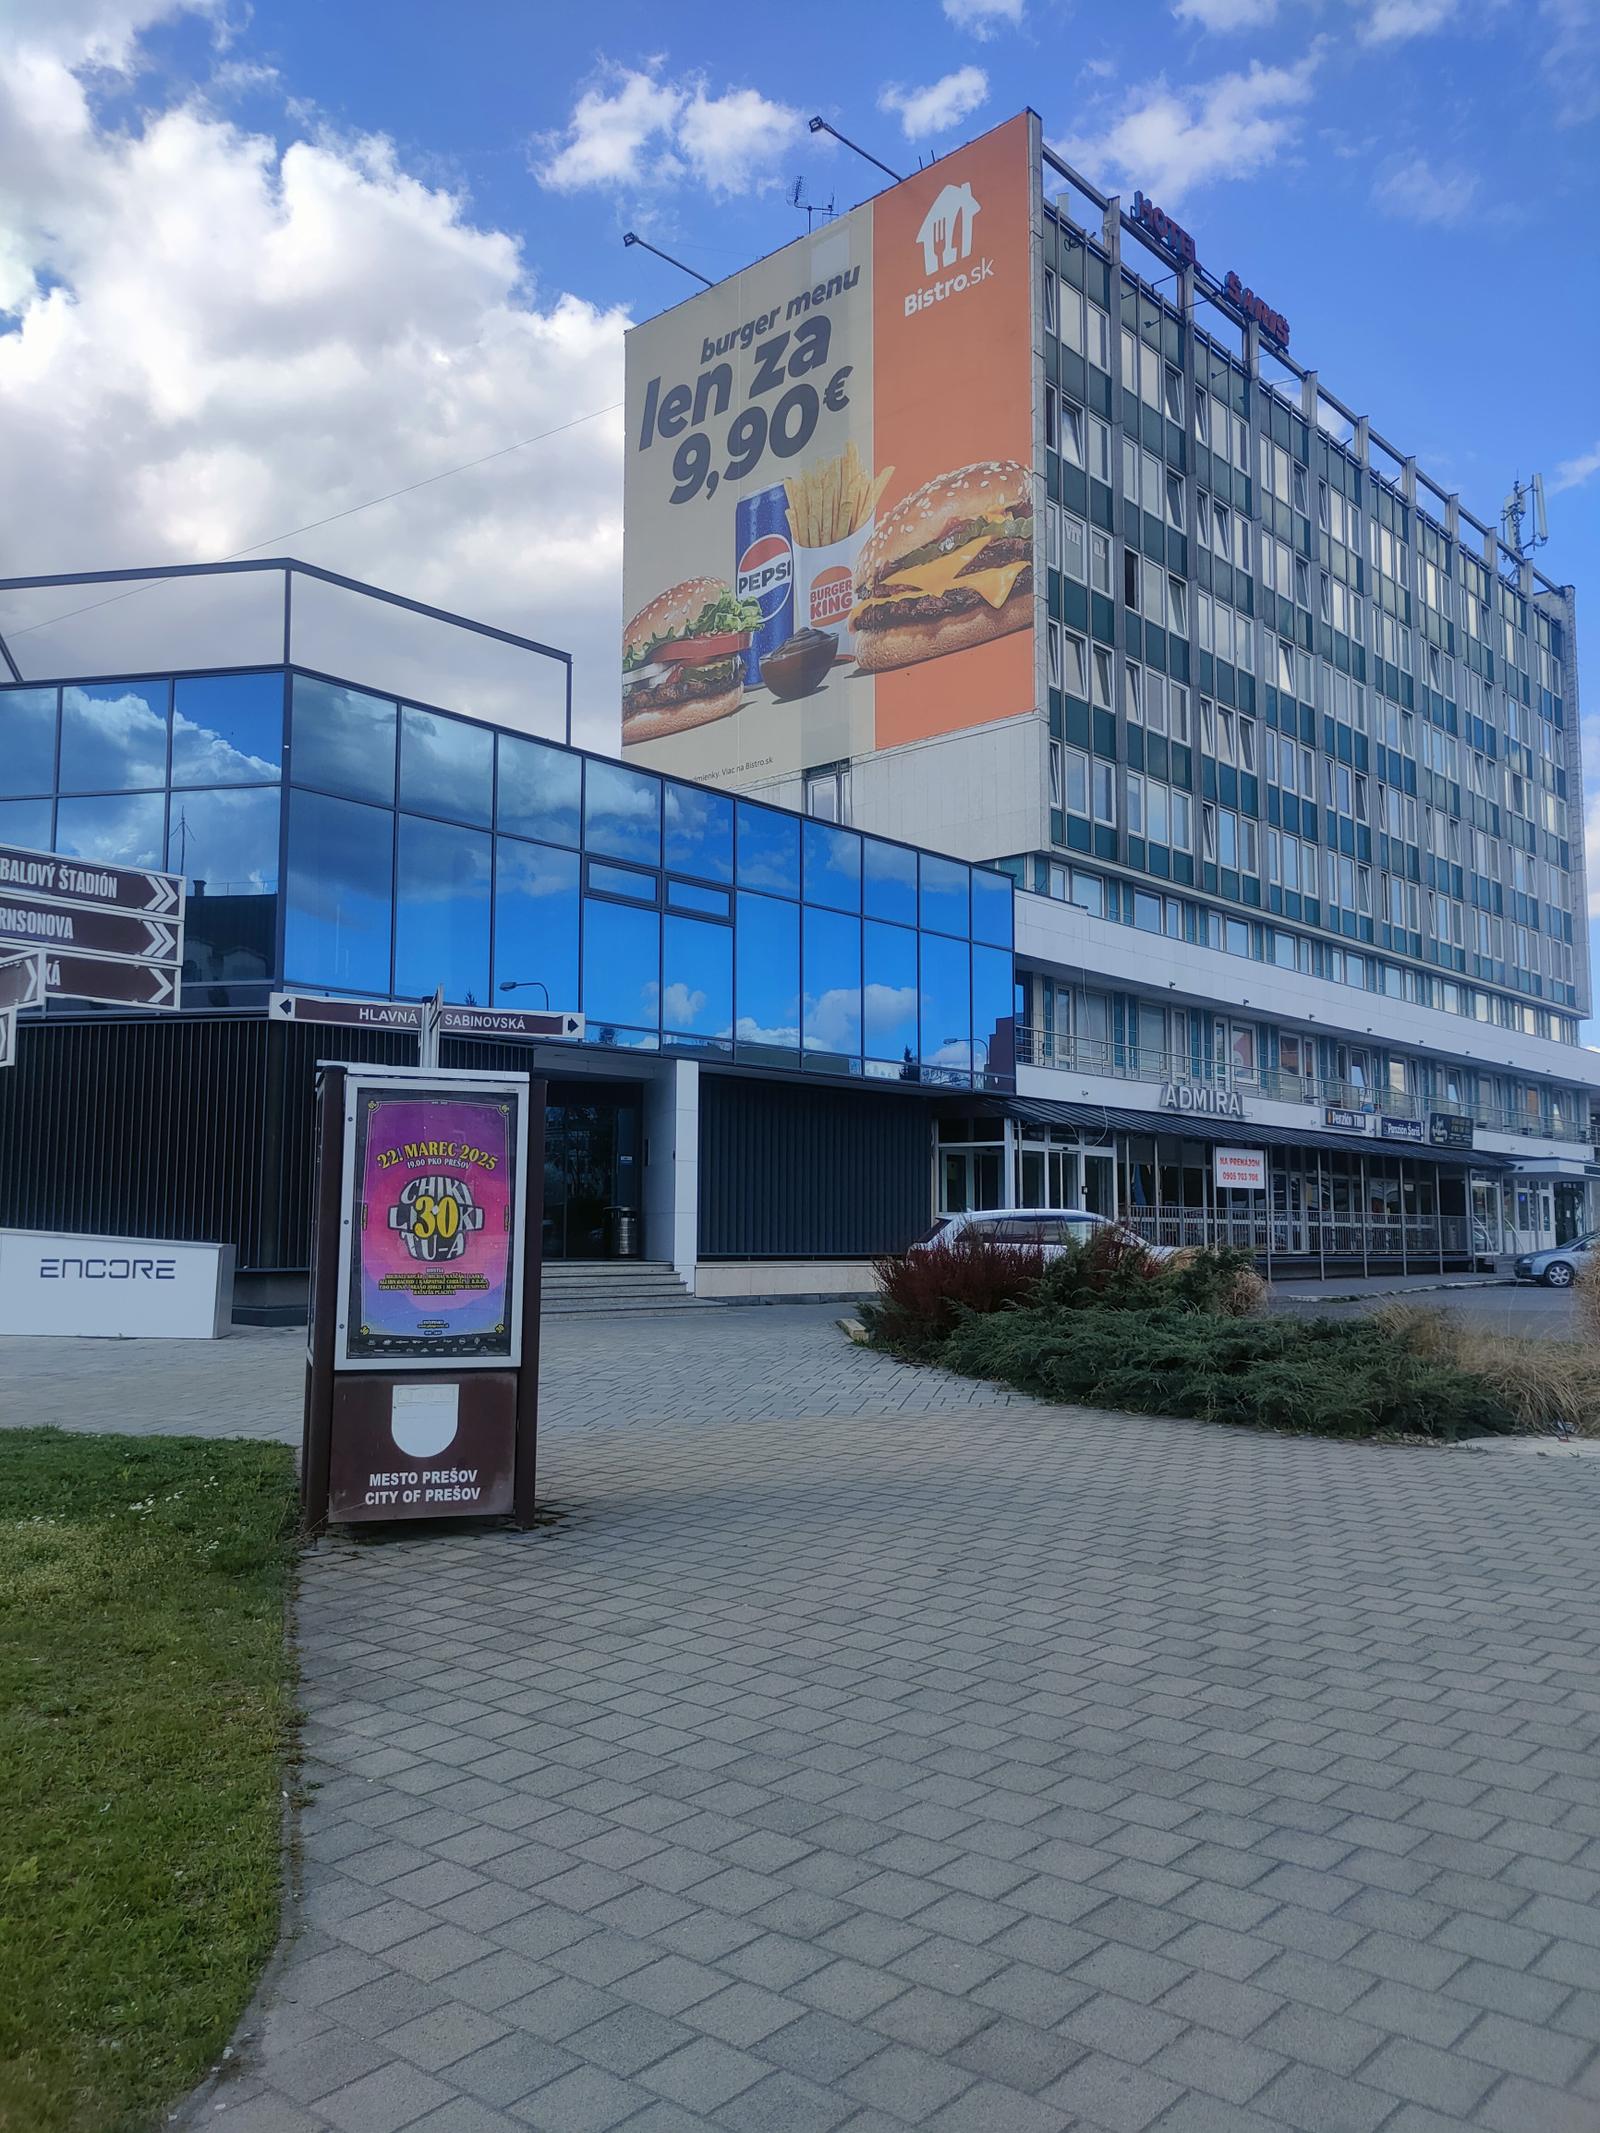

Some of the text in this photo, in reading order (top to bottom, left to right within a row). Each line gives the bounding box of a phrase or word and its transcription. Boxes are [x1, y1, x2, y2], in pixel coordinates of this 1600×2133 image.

[904, 256, 995, 317] Bistro.sk
[700, 265, 861, 365] burger menu
[639, 315, 832, 452] len za
[738, 559, 791, 594] PEPSI
[810, 579, 853, 604] BURGER
[810, 592, 853, 620] KING
[0, 857, 118, 899] BALOVÝ ŠTADIÓN
[359, 1008, 419, 1025] HLAVNÁ
[444, 1013, 526, 1031] SABINOVSKÁ
[1162, 1083, 1253, 1118] ADMIRAL
[404, 1141, 458, 1159] MAREC
[459, 1144, 499, 1171] 2025
[427, 1158, 442, 1166] PKO
[444, 1157, 471, 1170] PREŠOV
[400, 1176, 473, 1205] CHIKI
[413, 1195, 460, 1239] 30
[401, 1233, 465, 1261] TU-A
[40, 1258, 177, 1280] ENCORE
[369, 1467, 478, 1487] MESTO PREŠOV
[364, 1485, 481, 1506] CITY OF PREŠOV
